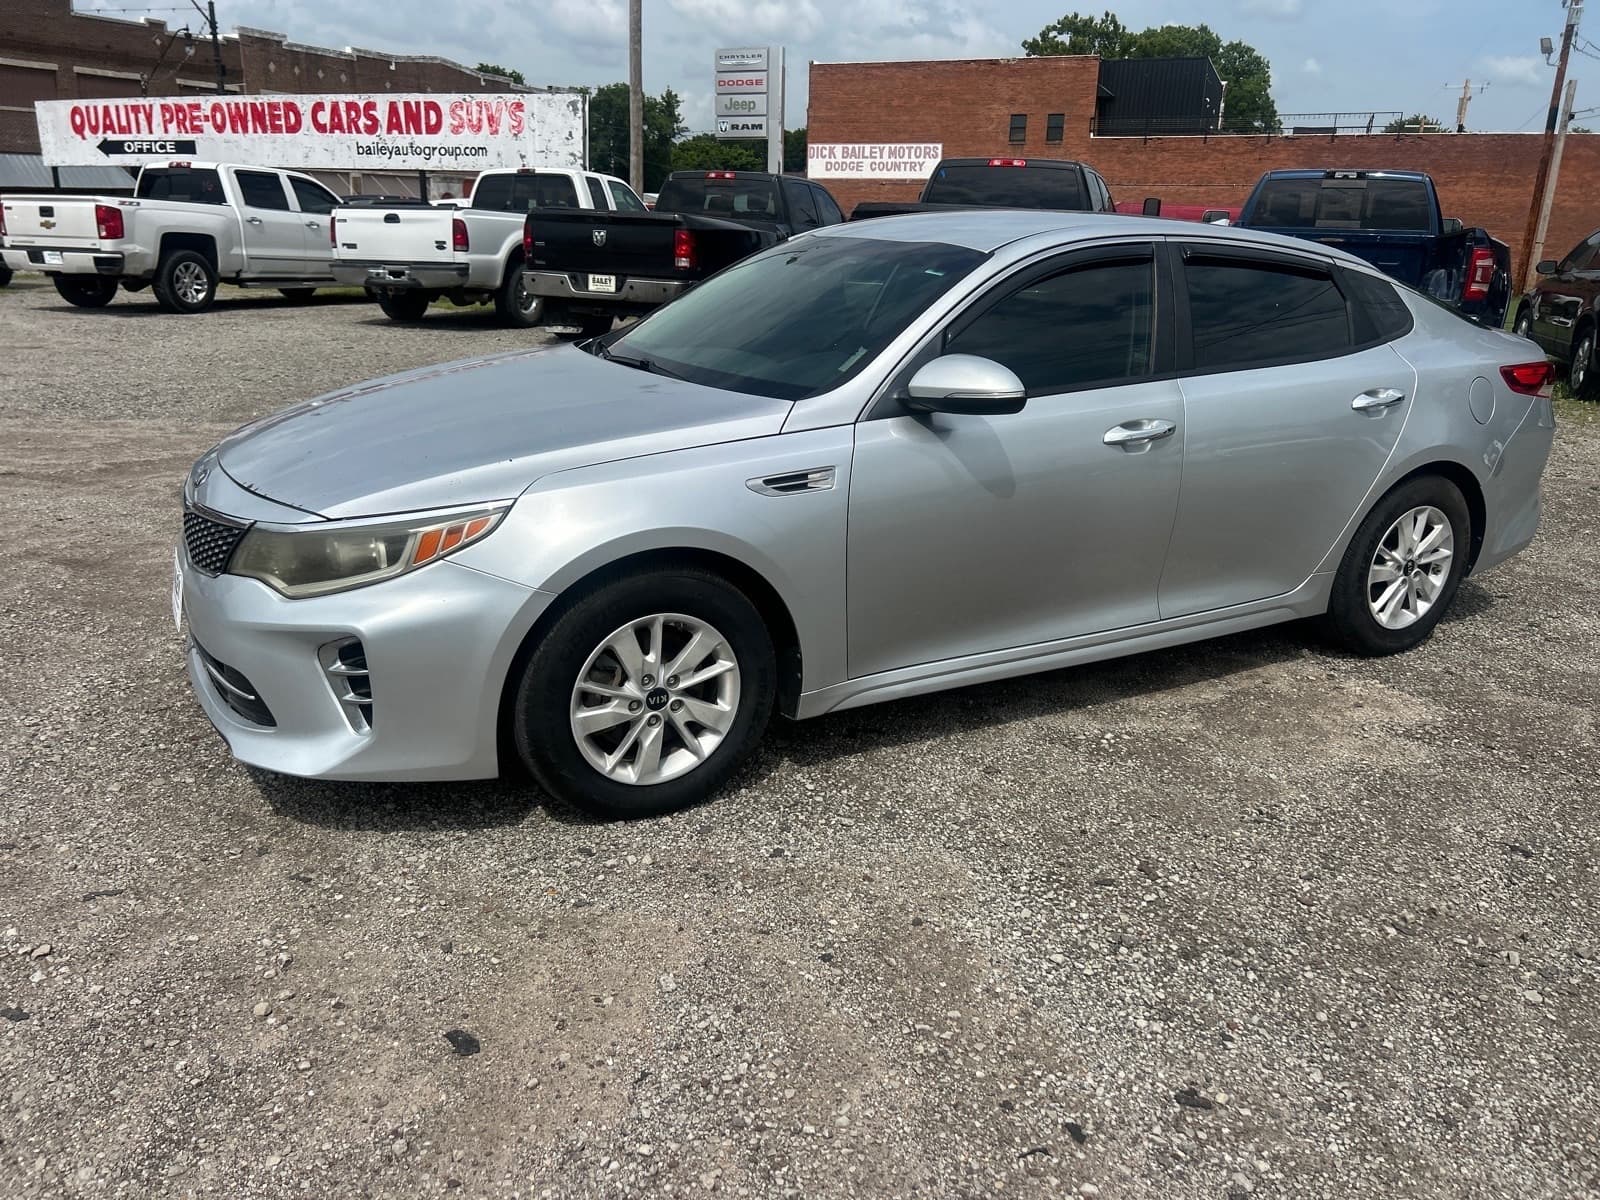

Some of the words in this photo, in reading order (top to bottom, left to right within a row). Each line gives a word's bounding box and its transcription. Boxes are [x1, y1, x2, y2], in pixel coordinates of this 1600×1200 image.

[718, 79, 764, 87] DODGE
[724, 97, 756, 112] Jeep
[70, 103, 153, 139] QUALITY
[160, 101, 303, 135] PRE-OWNED
[311, 101, 379, 135] CARS
[386, 101, 443, 135] AND
[449, 101, 525, 135] SUV'S
[731, 123, 763, 131] RAM
[123, 141, 176, 153] OFFICE
[356, 141, 488, 160] baileyautogroup.com
[808, 146, 837, 160] DICK
[841, 146, 886, 160] BAILEY
[888, 146, 939, 160] MOTORS
[825, 161, 865, 172] DODGE
[869, 161, 926, 172] COUNTRY
